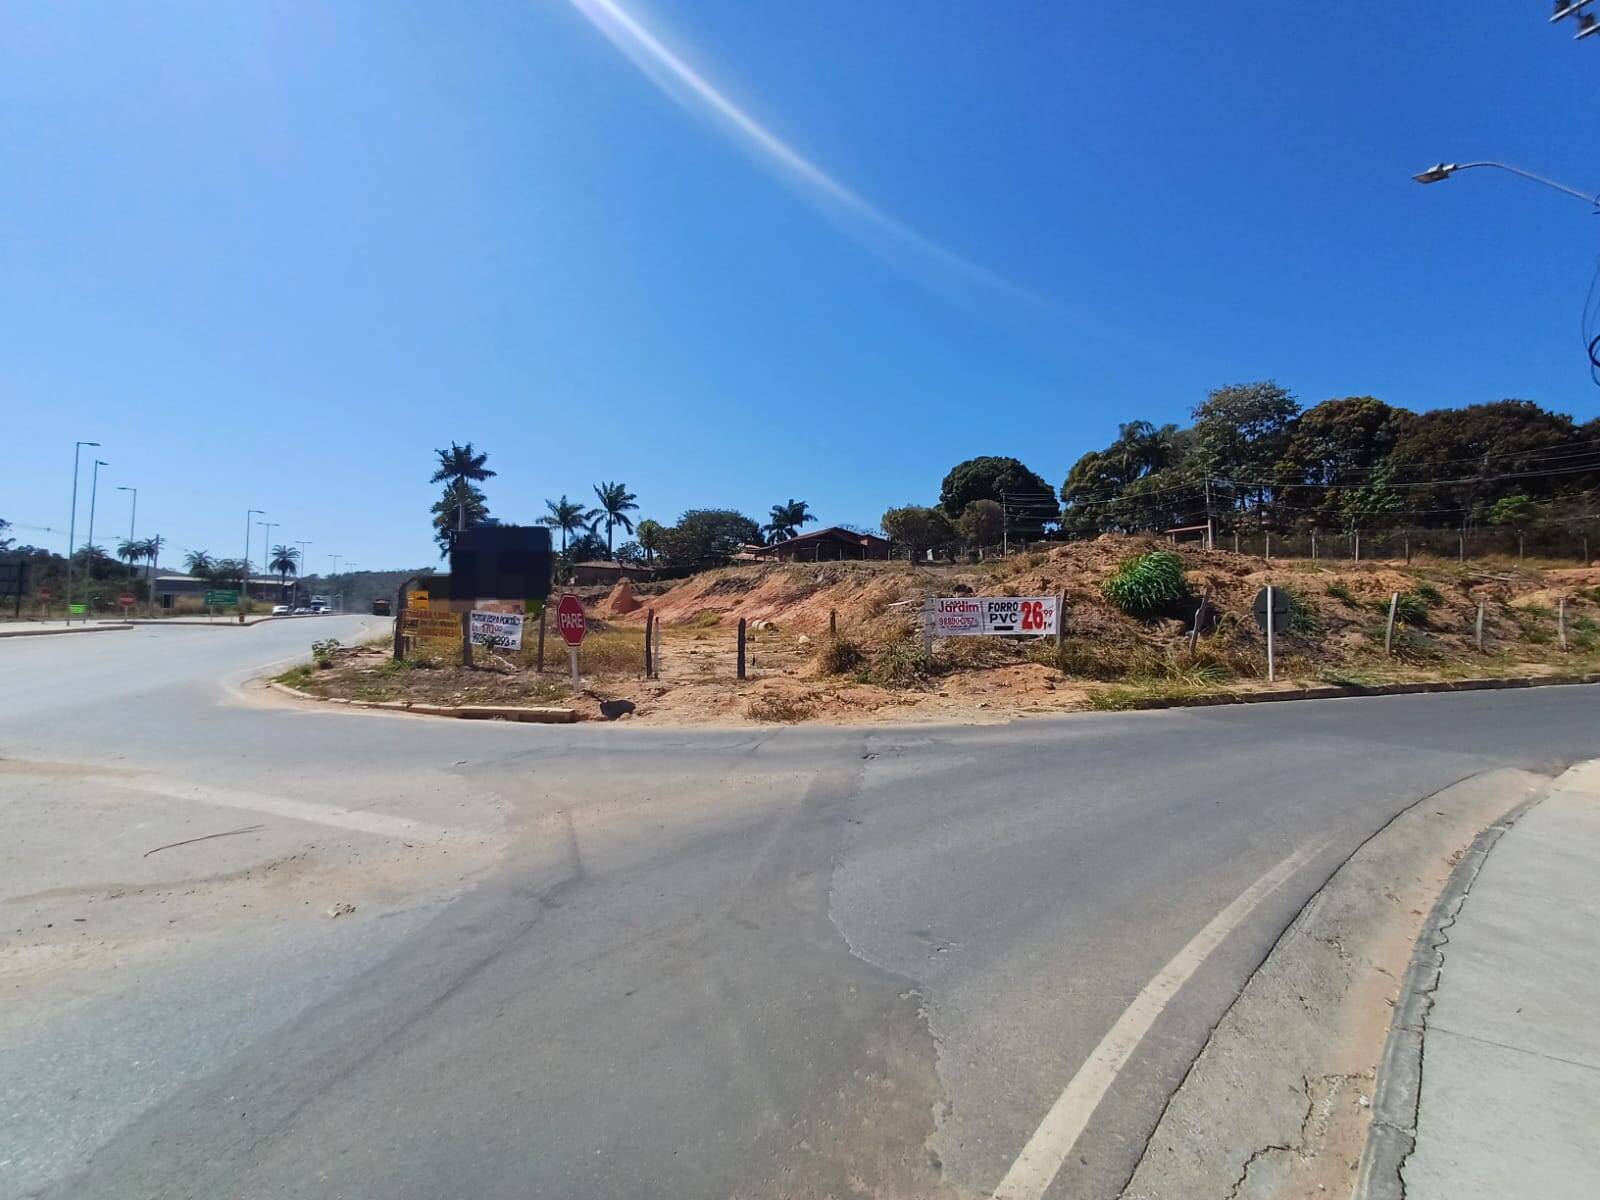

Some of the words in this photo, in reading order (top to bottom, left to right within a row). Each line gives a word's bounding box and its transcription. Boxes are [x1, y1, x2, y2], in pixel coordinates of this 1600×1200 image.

[938, 600, 979, 612] Jardim
[988, 601, 1019, 612] FORRO
[560, 612, 584, 629] PARE
[989, 612, 1018, 623] PVC
